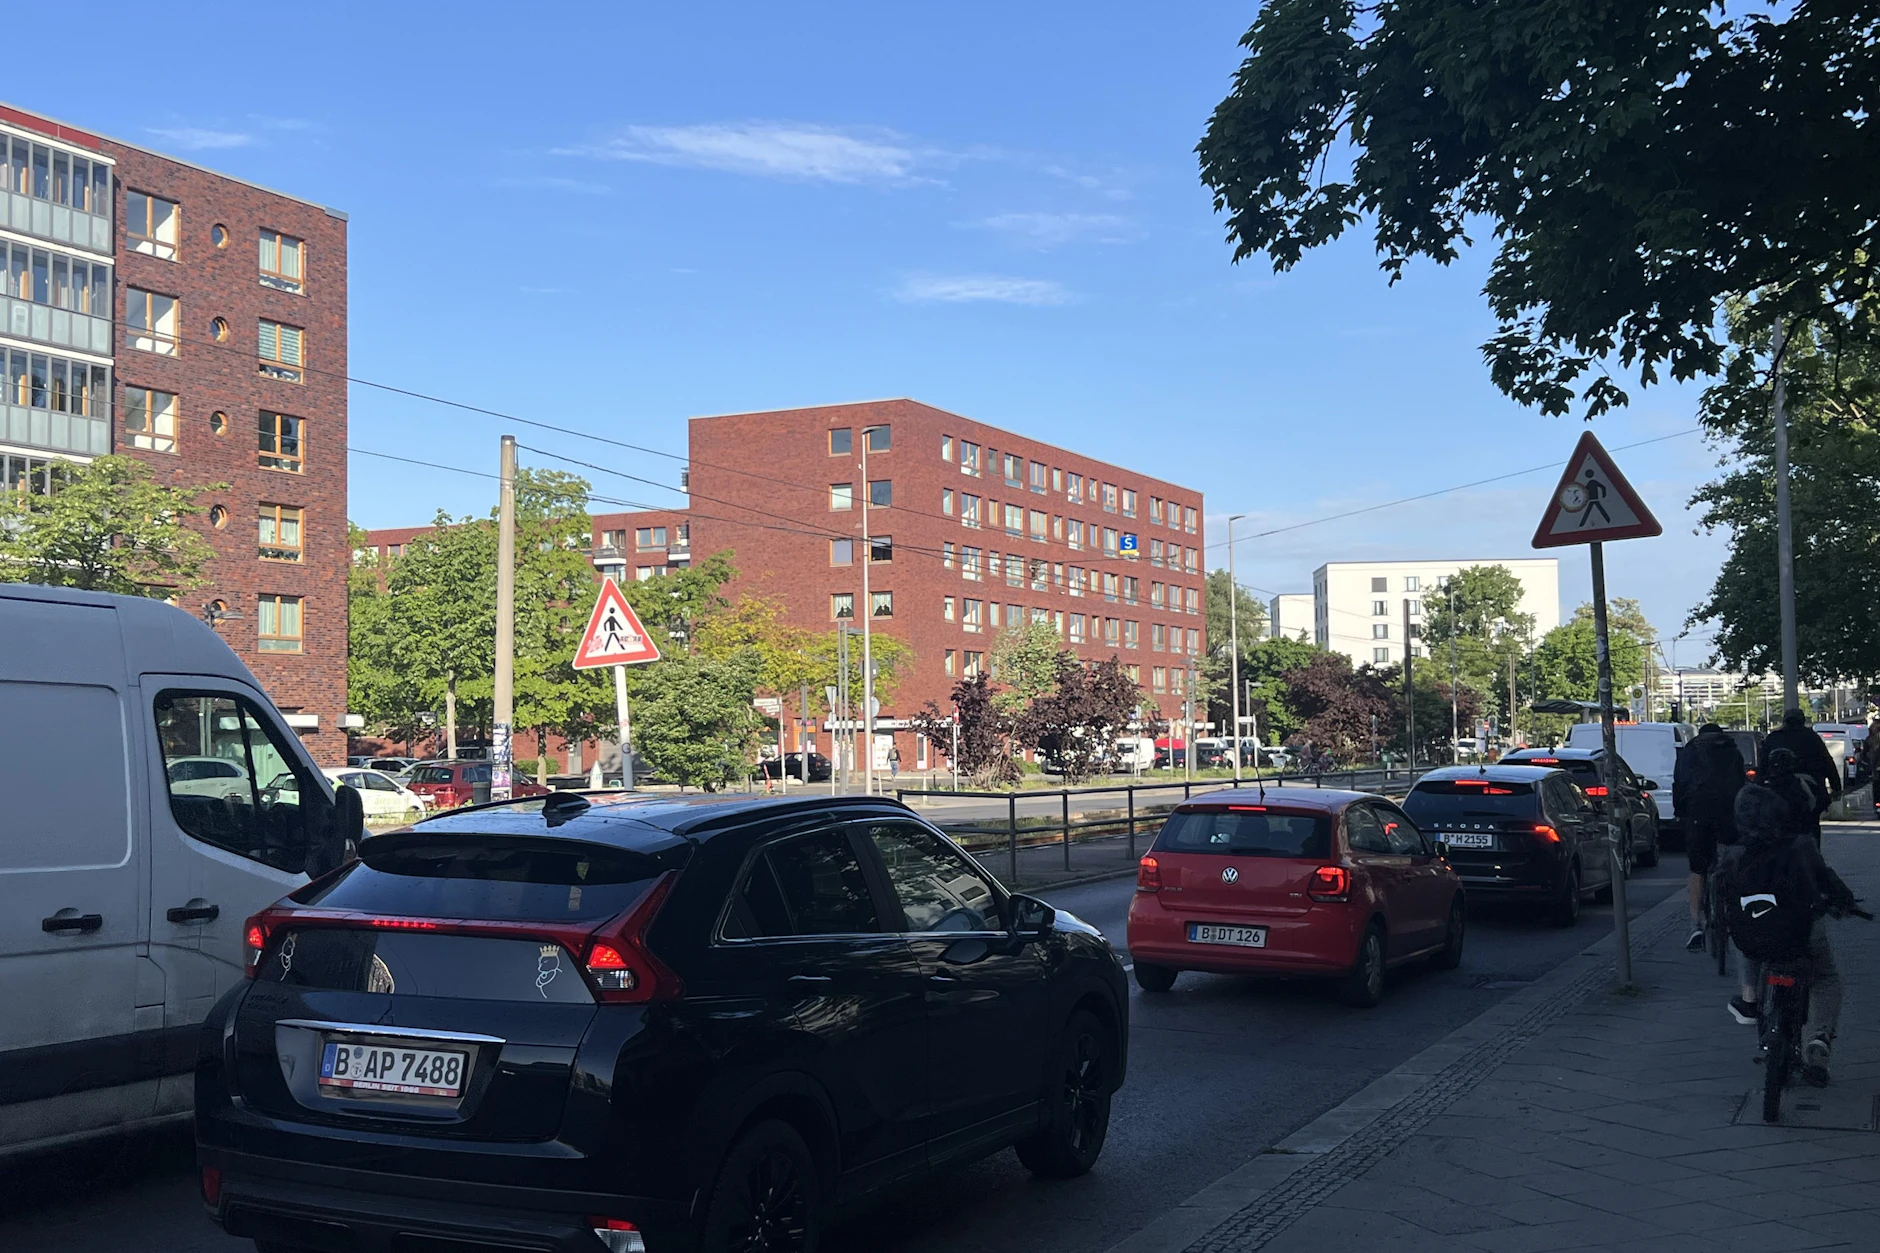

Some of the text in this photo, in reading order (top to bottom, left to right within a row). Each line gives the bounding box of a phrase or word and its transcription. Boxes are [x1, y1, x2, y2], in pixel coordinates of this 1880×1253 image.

[1124, 537, 1133, 549] S
[1444, 834, 1488, 845] B H 2155
[1202, 927, 1260, 943] B DT 126
[334, 1048, 460, 1086] B AP 7488
[353, 1080, 380, 1090] BERLIN
[382, 1083, 399, 1092] SEIT
